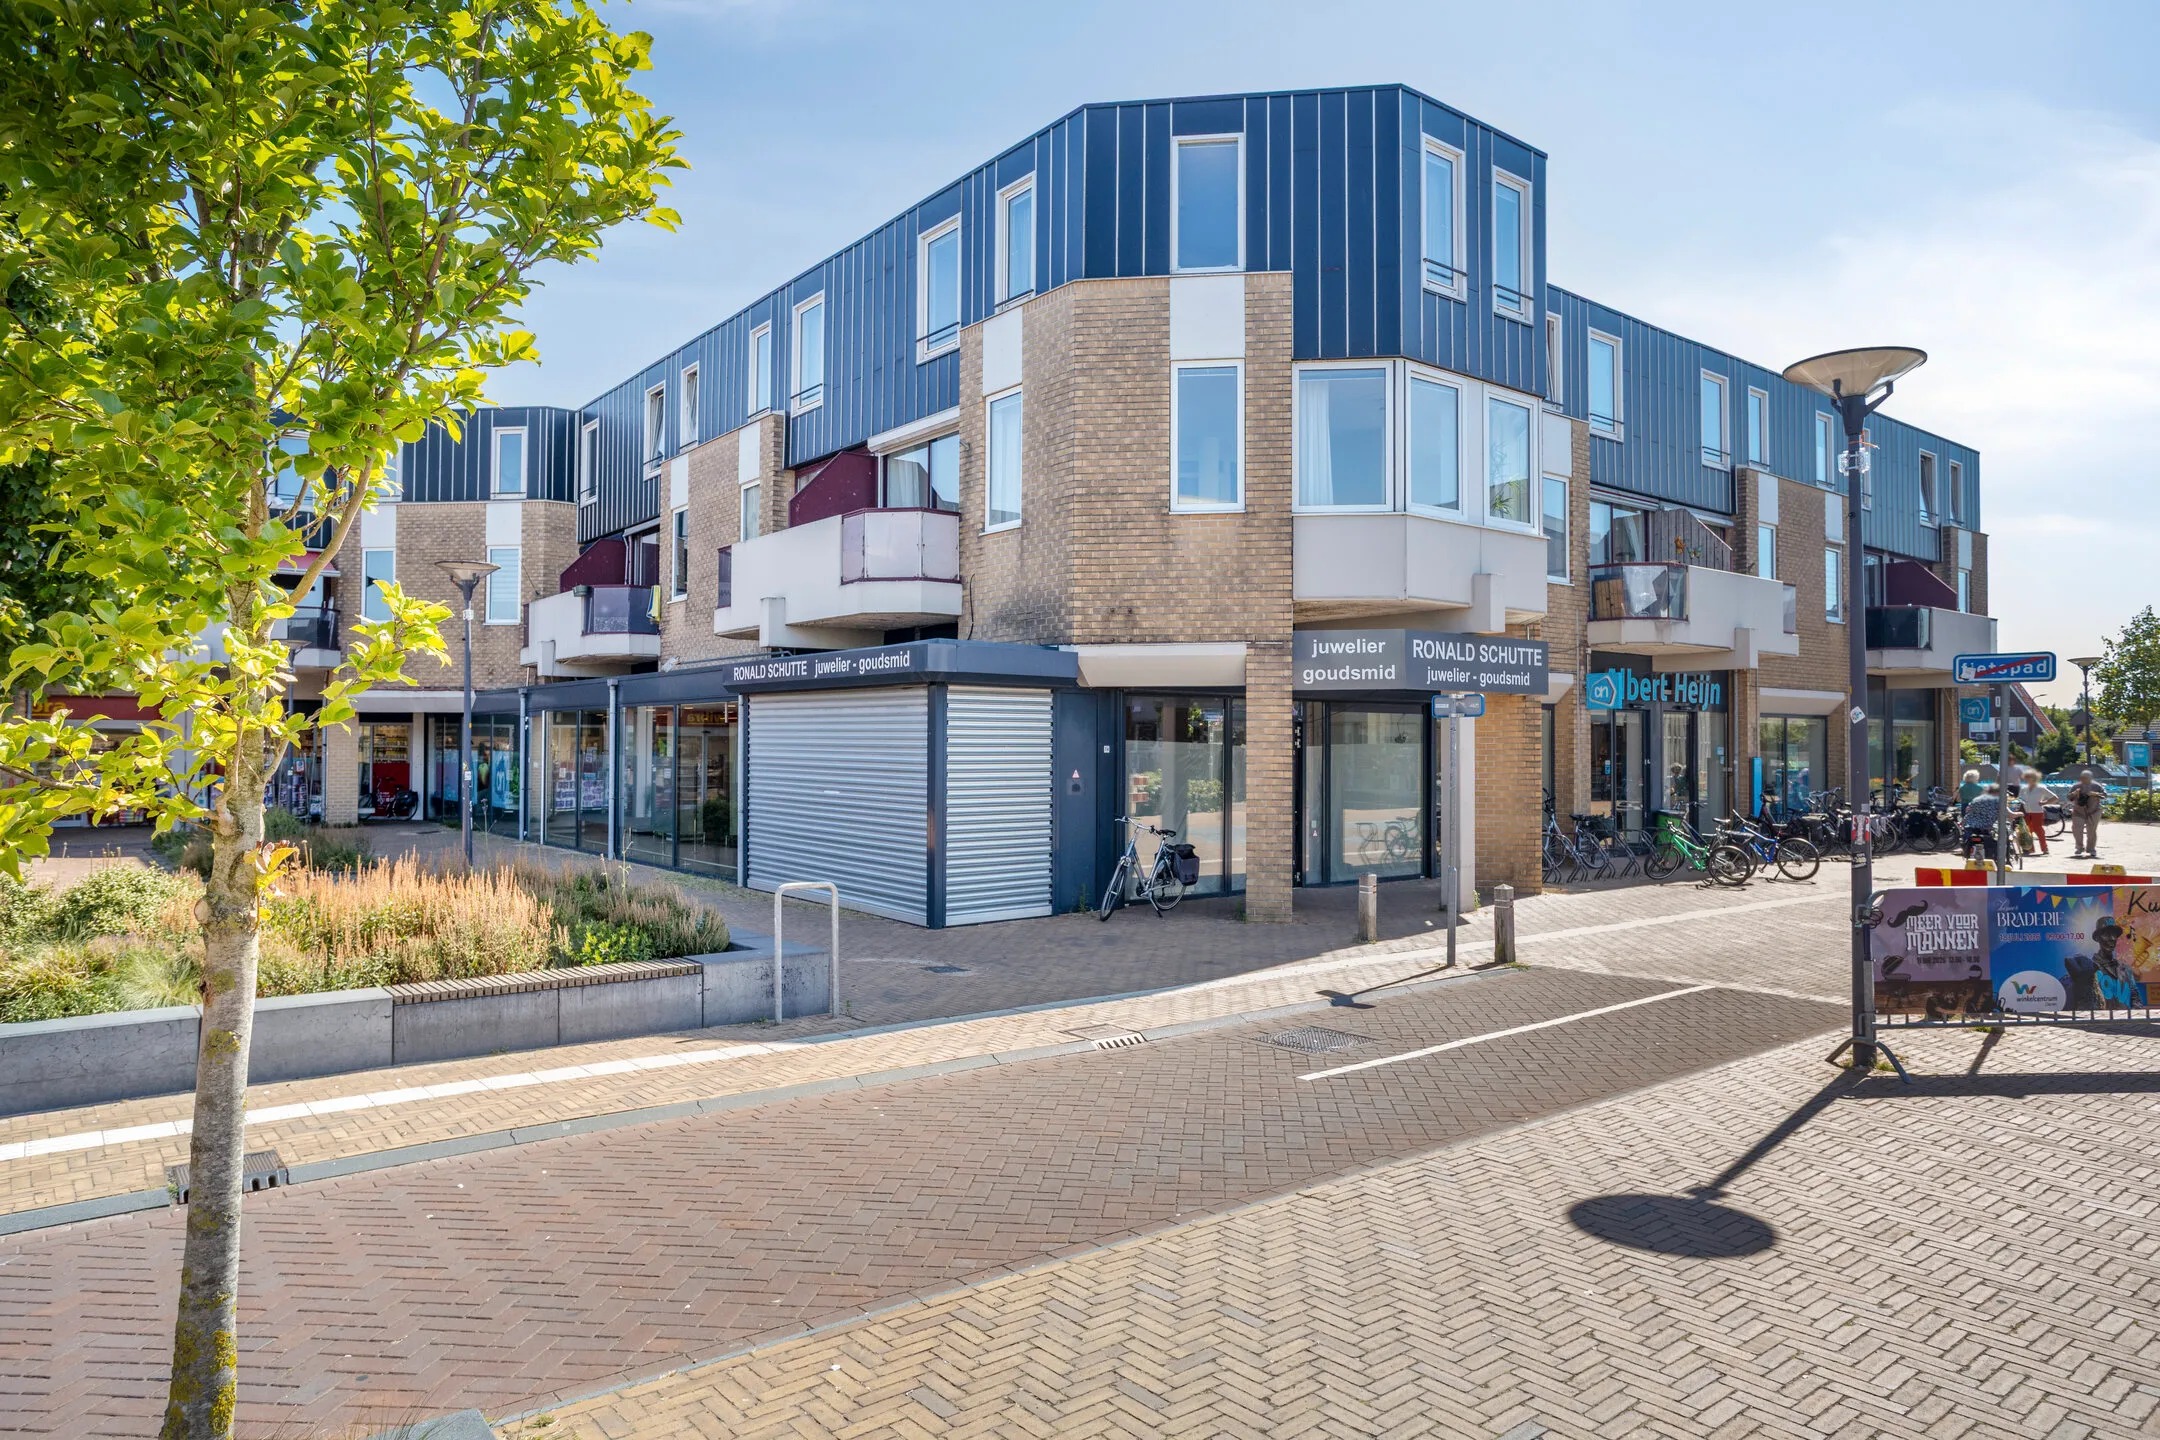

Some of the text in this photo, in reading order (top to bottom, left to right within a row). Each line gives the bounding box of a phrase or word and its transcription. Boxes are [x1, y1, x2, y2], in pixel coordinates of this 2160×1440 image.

[1312, 638, 1386, 658] juwelier
[1412, 639, 1542, 667] RONALD SCHUTTE
[733, 664, 766, 681] RONALD
[767, 660, 808, 678] SCHUTTE
[814, 656, 851, 678] juwelier
[858, 651, 910, 675] goudsmid
[1303, 664, 1396, 685] goudsmid
[1427, 666, 1471, 685] juwelier
[1480, 670, 1530, 687] goudsmid
[1961, 660, 2047, 676] fetspad
[1609, 668, 1720, 711] lbert Heijn
[1906, 914, 1979, 933] MEER VOOR
[1997, 911, 2065, 928] BRADERIE
[1906, 930, 1979, 954] MANNEN
